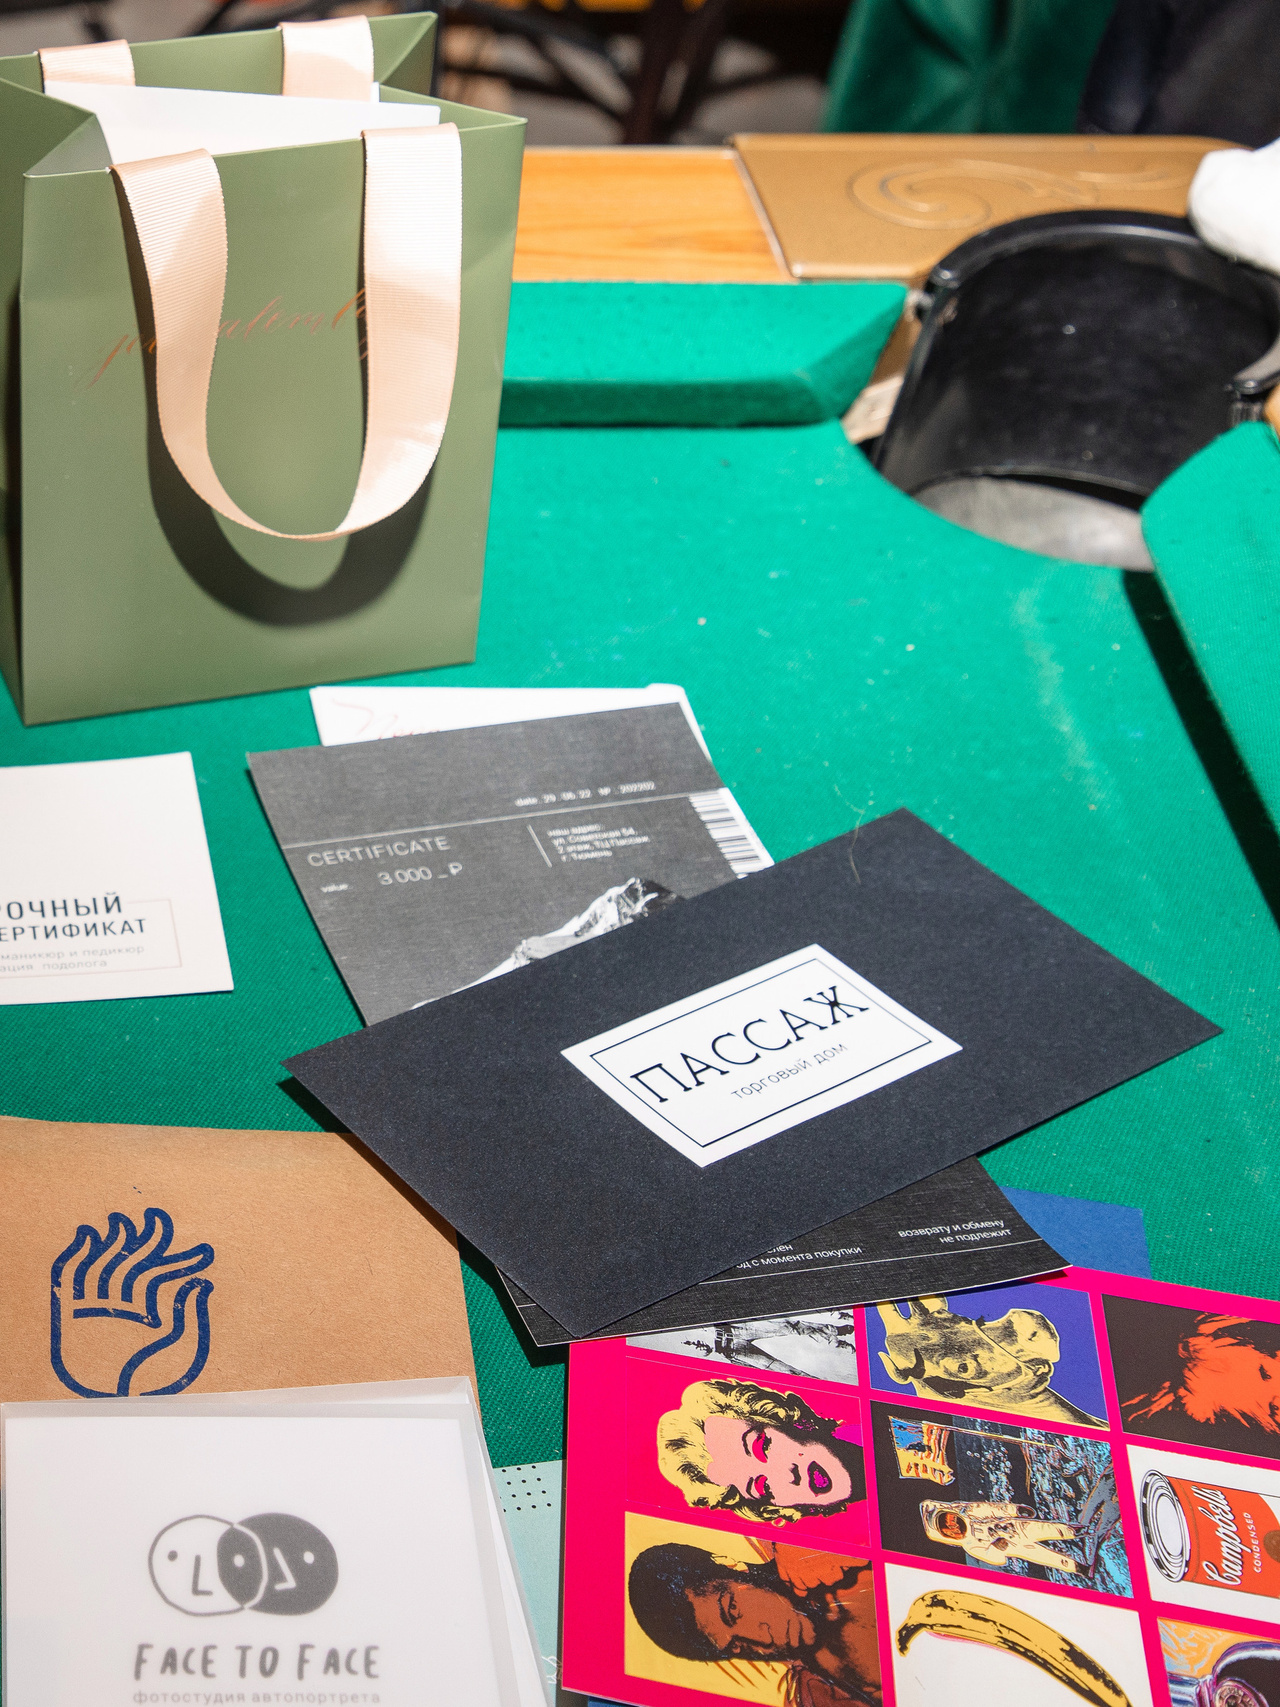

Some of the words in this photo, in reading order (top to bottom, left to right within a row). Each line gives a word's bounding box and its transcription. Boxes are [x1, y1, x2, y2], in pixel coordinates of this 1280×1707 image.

[307, 835, 451, 867] CERTIFICATE
[1, 950, 65, 963] маникюр
[82, 945, 145, 958] педикюр
[629, 985, 869, 1104] ПАССАЖ
[730, 1056, 814, 1100] торговый
[814, 1042, 849, 1068] дом
[898, 1224, 950, 1238] возврату
[962, 1219, 1005, 1232] обмену
[939, 1235, 955, 1244] не
[956, 1228, 1012, 1242] подлежит
[760, 1252, 813, 1266] момента
[814, 1246, 863, 1259] покупки
[1242, 1512, 1263, 1573] CONDENSED
[133, 1643, 219, 1681] FACE
[235, 1645, 280, 1680] TO
[297, 1643, 381, 1681] FACE
[132, 1689, 246, 1706] фотостудия
[251, 1691, 381, 1706] автопортрета
